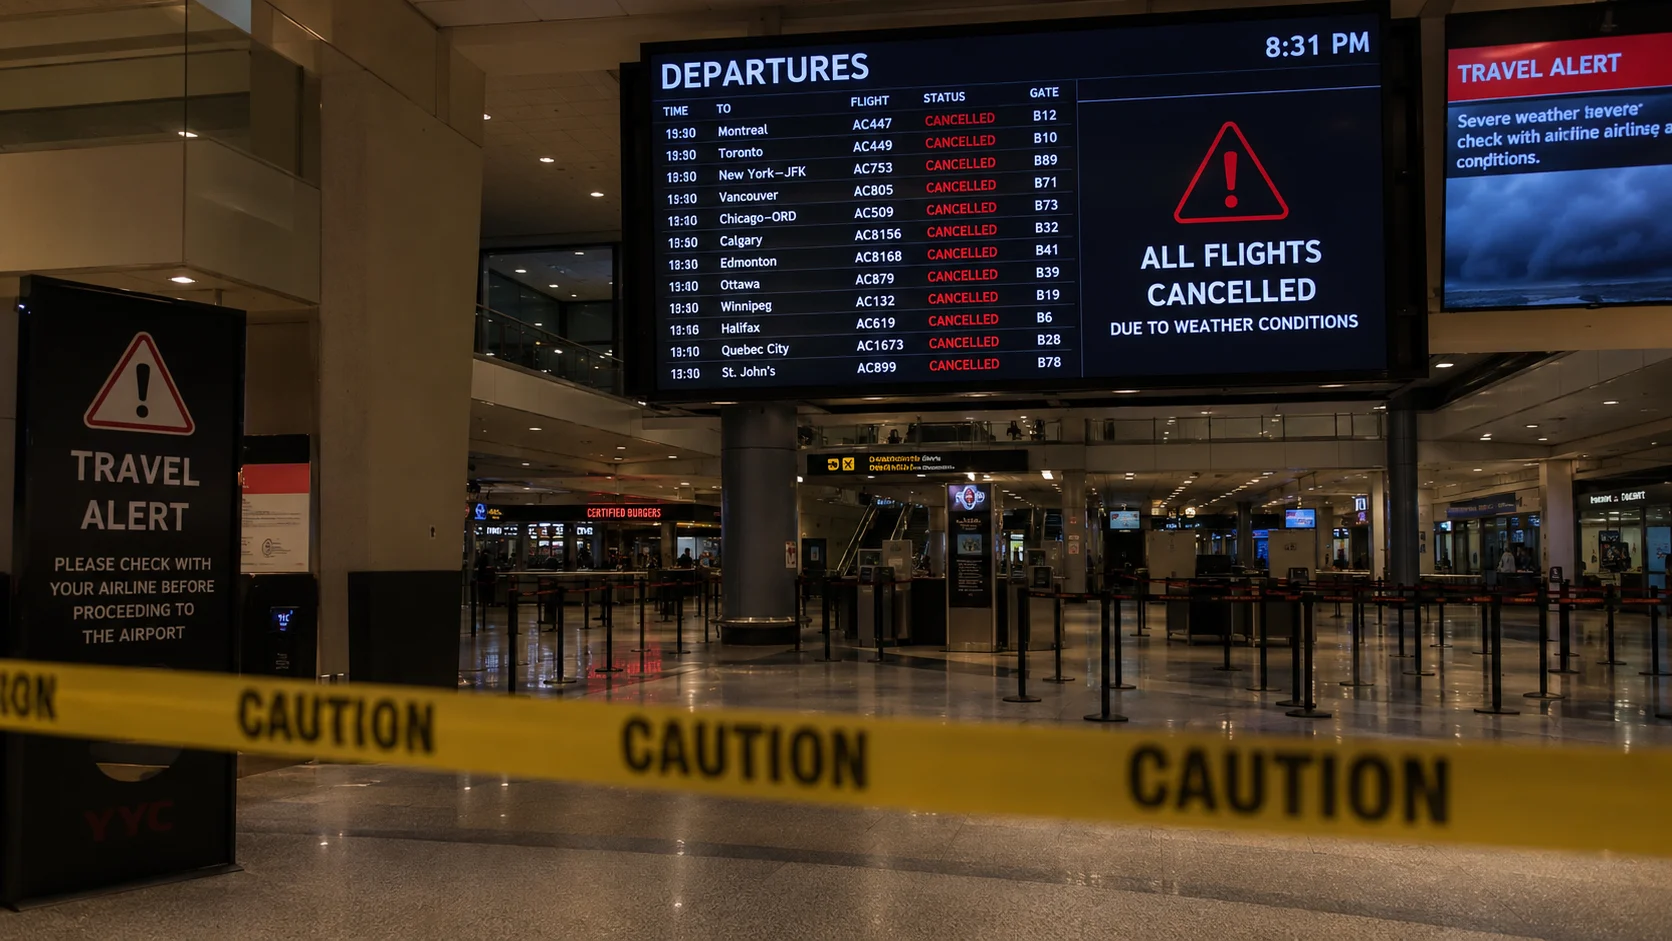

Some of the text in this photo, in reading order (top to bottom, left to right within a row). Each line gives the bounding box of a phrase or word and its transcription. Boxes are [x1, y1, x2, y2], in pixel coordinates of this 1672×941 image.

[1266, 32, 1369, 57] 8:31 PM
[662, 53, 869, 89] DEPARTURES
[1458, 53, 1622, 82] TRAVEL ALERT
[663, 87, 1059, 116] TIME TO FLIGHT STATUS GATE
[718, 124, 768, 136] Montreal
[853, 118, 892, 130] AC447
[926, 113, 995, 126] CANCELLED
[1034, 110, 1056, 121] B12
[1458, 114, 1511, 128] Severe
[1515, 106, 1581, 124] weather
[718, 147, 763, 158] Toronto
[853, 140, 892, 152] AC449
[926, 135, 995, 148] CANCELLED
[1034, 132, 1057, 143] B10
[1457, 132, 1502, 148] check
[1507, 129, 1540, 145] with
[719, 170, 744, 180] New
[854, 162, 892, 174] AC753
[926, 157, 996, 170] CANCELLED
[1035, 154, 1057, 166] B89
[719, 192, 778, 202] Vancouver
[854, 184, 893, 196] AC805
[926, 180, 996, 193] CANCELLED
[1035, 177, 1056, 188] B71
[854, 207, 893, 218] AC509
[927, 202, 996, 215] CANCELLED
[1035, 199, 1058, 211] B73
[720, 235, 762, 248] Calgary
[855, 228, 901, 240] AC8156
[927, 224, 997, 237] CANCELLED
[1036, 222, 1058, 233] B32
[721, 257, 776, 268] Edmonton
[855, 251, 902, 263] AC8168
[928, 247, 997, 260] CANCELLED
[1036, 244, 1057, 255] B41
[1141, 240, 1321, 269] ALL FLIGHTS
[721, 280, 760, 290] Ottawa
[856, 273, 894, 285] AC879
[928, 269, 998, 282] CANCELLED
[1036, 267, 1059, 278] B39
[721, 300, 772, 313] Winnipeg
[856, 295, 895, 307] AC132
[928, 292, 998, 304] CANCELLED
[1037, 289, 1059, 300] B19
[1148, 278, 1316, 306] CANCELLED
[722, 322, 760, 333] Halifax
[856, 317, 895, 329] AC619
[928, 314, 998, 326] CANCELLED
[1037, 312, 1052, 323] B6
[1111, 314, 1358, 335] DUE TO WEATHER CONDITIONS
[722, 344, 763, 357] Quebec
[767, 343, 789, 356] City
[857, 339, 903, 351] AC1673
[929, 336, 999, 348] CANCELLED
[1038, 334, 1061, 345] B28
[722, 367, 736, 377] St.
[740, 366, 775, 377] John's
[857, 362, 896, 373] AC899
[930, 358, 999, 371] CANCELLED
[1038, 357, 1061, 368] B78
[71, 450, 199, 486] TRAVEL
[81, 500, 189, 530] ALERT
[587, 508, 662, 518] CERTIFIED BURGERS
[55, 558, 211, 571] PLEASE CHECK WITH
[50, 580, 214, 596] YOUR AIRLINE BEFORE
[74, 603, 194, 619] PROCEEDING TO
[83, 626, 185, 643] THE AIRPORT
[238, 688, 436, 754] CAUTION
[621, 717, 868, 791] CAUTION
[1127, 742, 1450, 825] CAUTION
[83, 800, 173, 842] YYC
